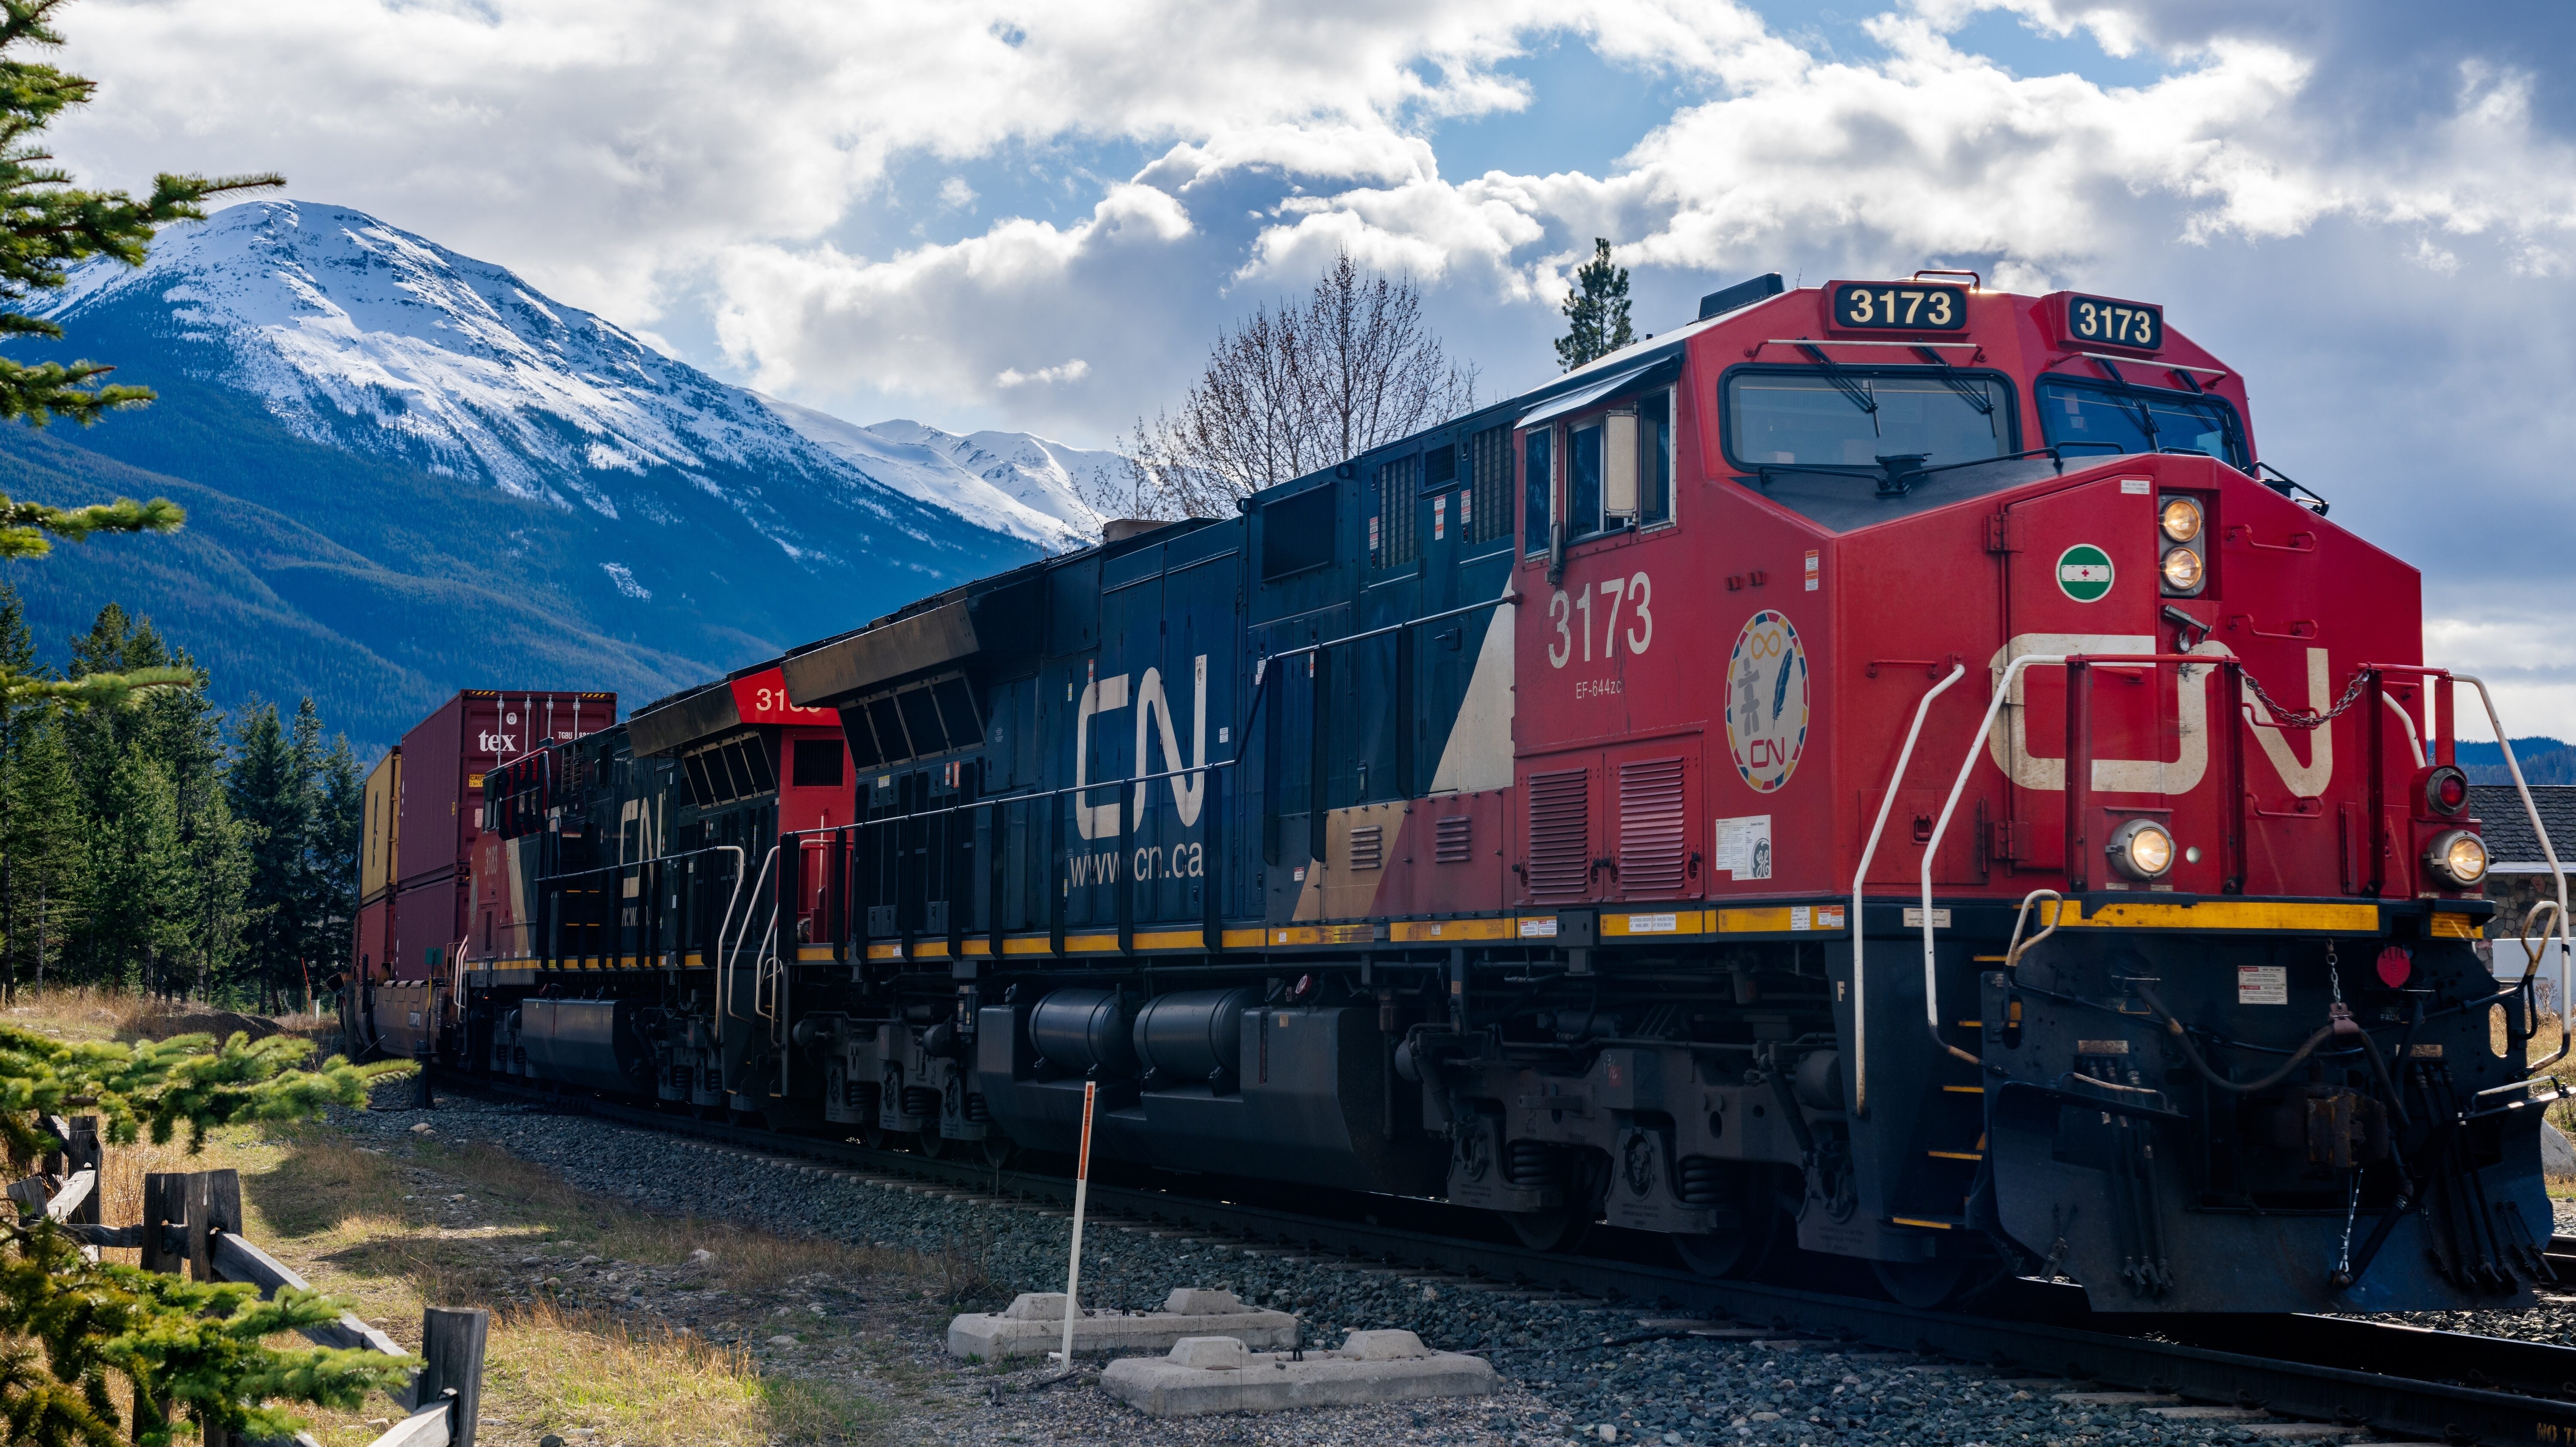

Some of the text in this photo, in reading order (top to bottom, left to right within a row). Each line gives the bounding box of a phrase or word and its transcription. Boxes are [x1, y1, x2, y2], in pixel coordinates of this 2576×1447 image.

[1850, 289, 1951, 325] 3173
[2079, 302, 2151, 344] 3173
[1548, 572, 1653, 669] 3173
[756, 688, 821, 713] 31
[1576, 678, 1622, 699] EF-644zc
[1989, 633, 2333, 796] CN
[479, 730, 517, 752] tex
[1076, 654, 1207, 839] CN
[1750, 737, 1784, 768] CN
[485, 845, 497, 876] 3183
[620, 793, 663, 898] CN
[1070, 842, 1204, 888] wwwcn.ca
[1838, 981, 1845, 1001] F
[2536, 1422, 2576, 1447] NO T
